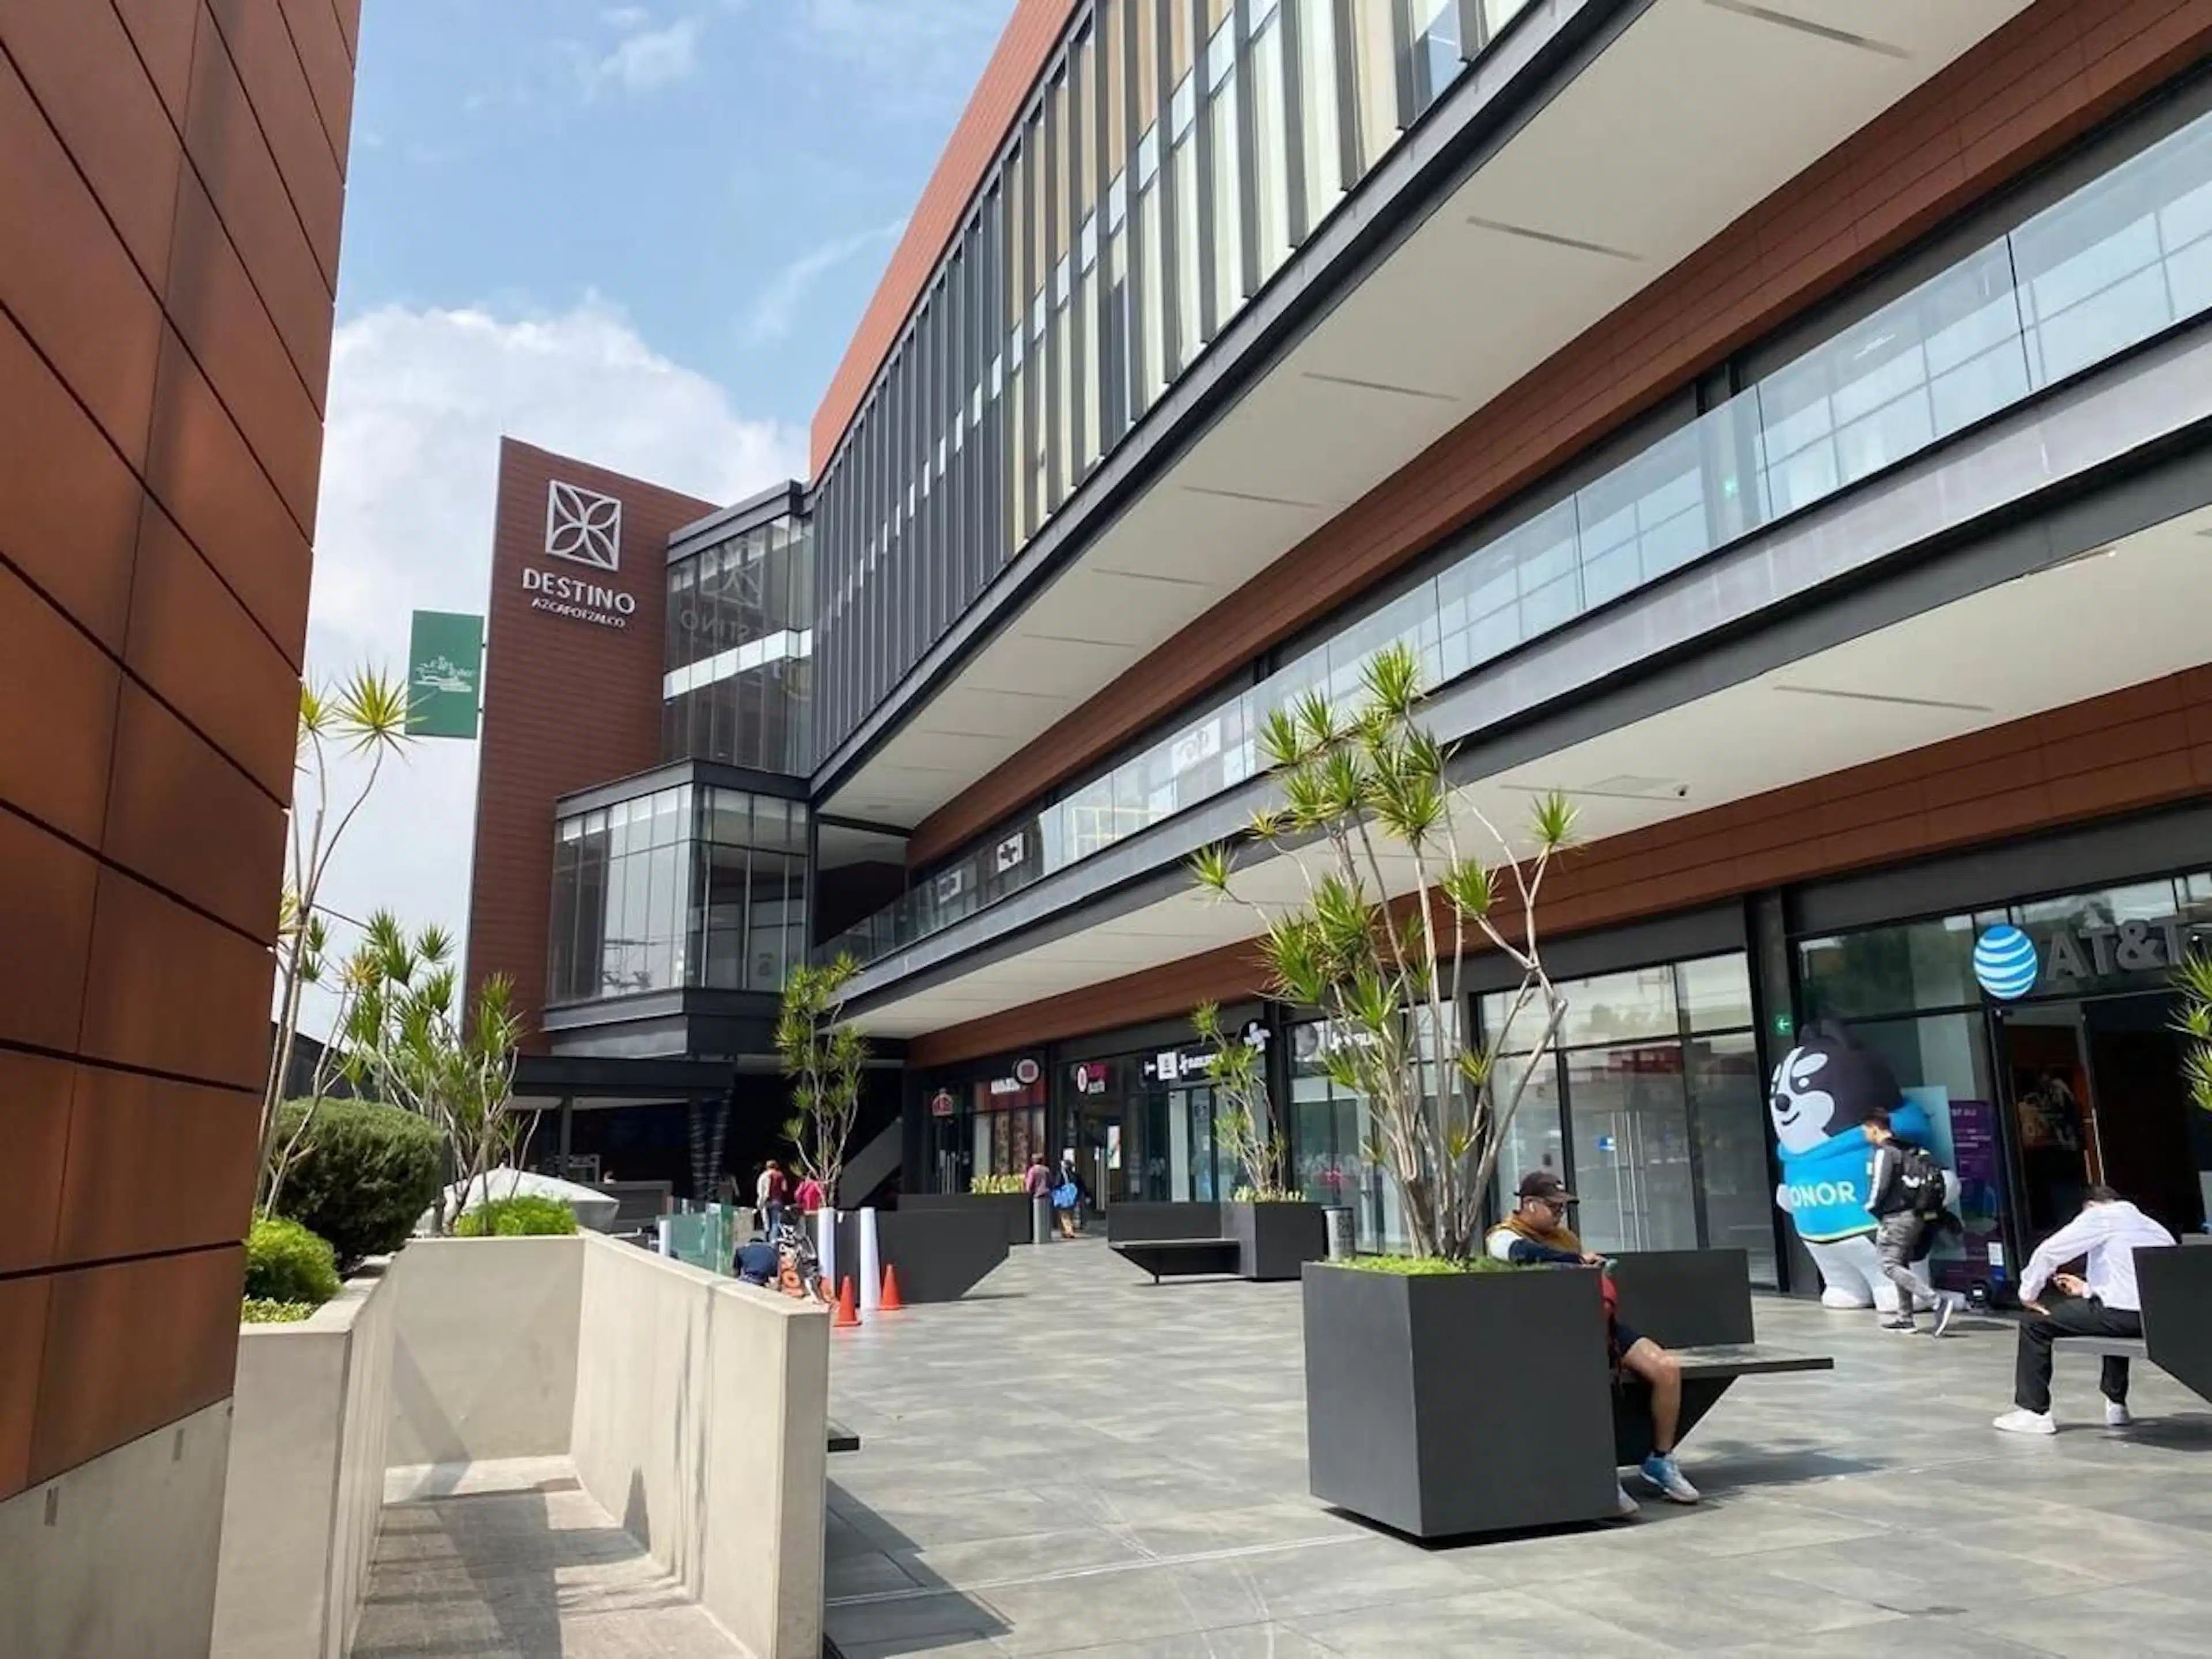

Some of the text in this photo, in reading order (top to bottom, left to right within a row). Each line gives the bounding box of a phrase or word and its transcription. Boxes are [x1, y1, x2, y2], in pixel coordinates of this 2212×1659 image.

[522, 567, 636, 615] DESTINO
[2046, 918, 2188, 980] AT&T
[1788, 1181, 1857, 1207] ONOR
